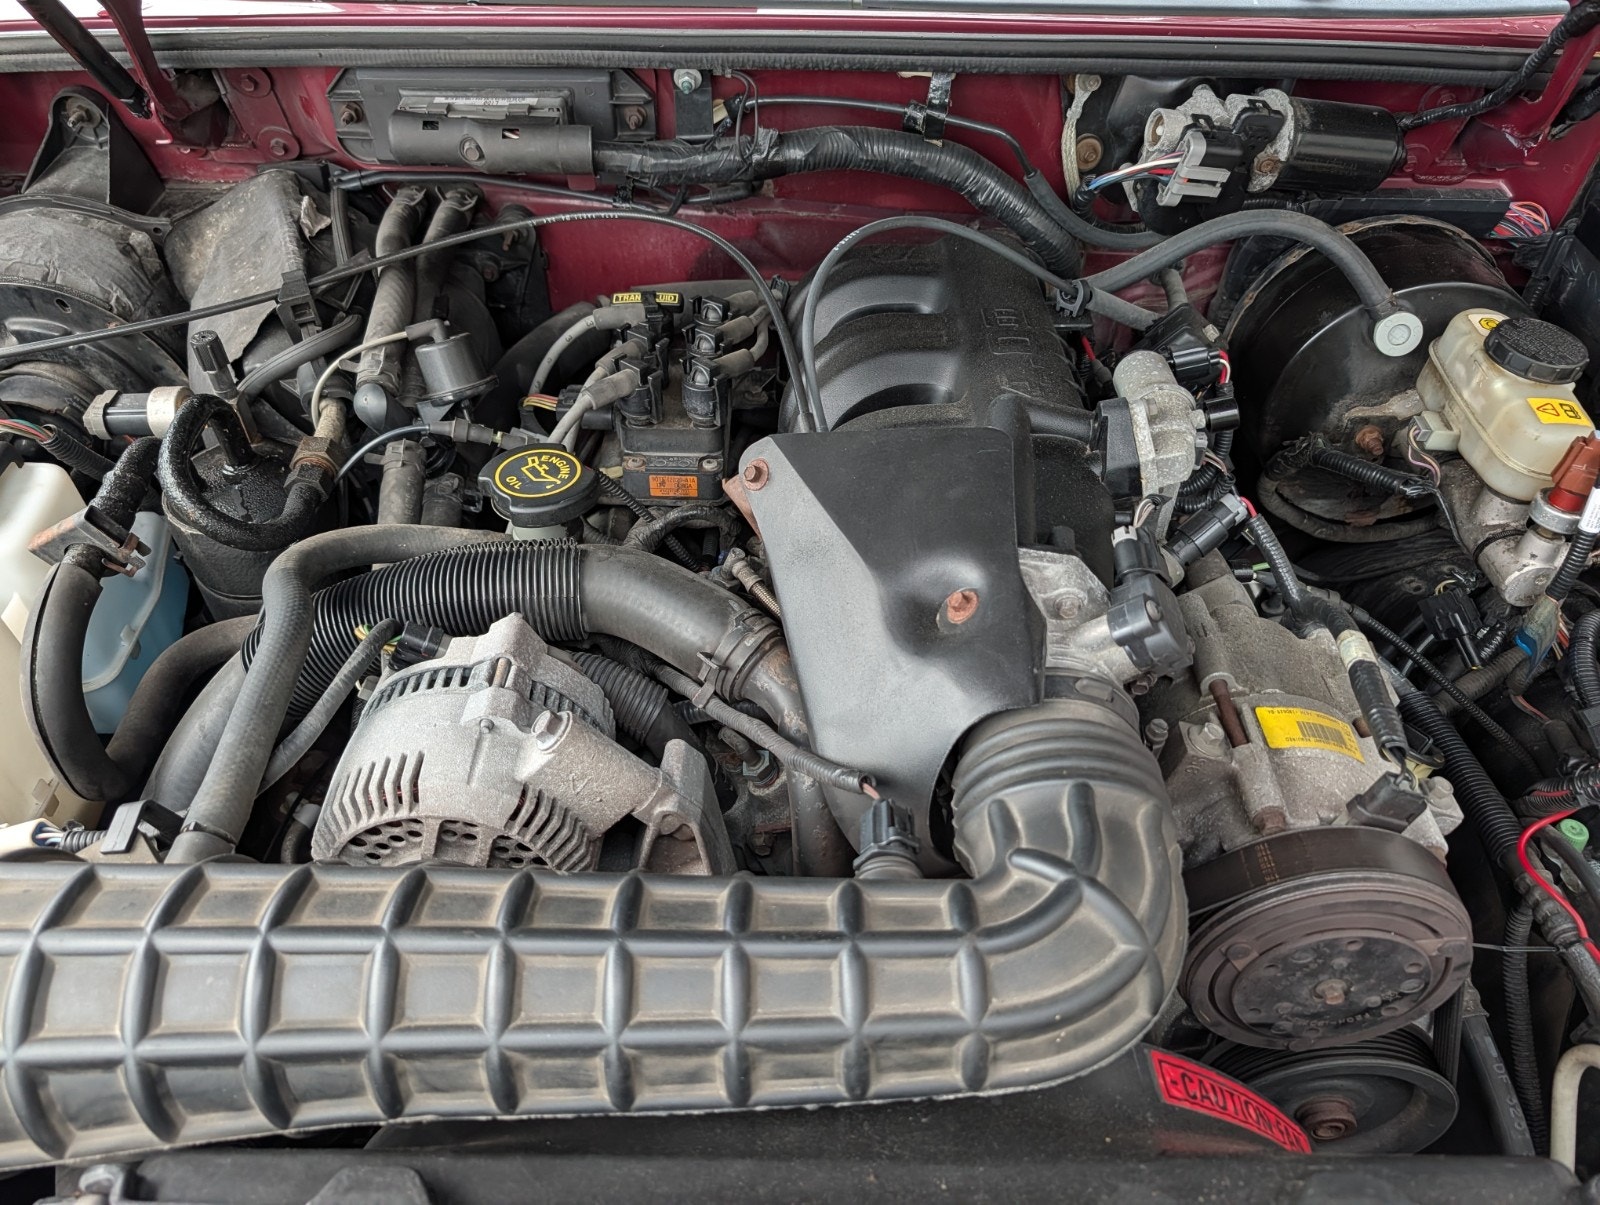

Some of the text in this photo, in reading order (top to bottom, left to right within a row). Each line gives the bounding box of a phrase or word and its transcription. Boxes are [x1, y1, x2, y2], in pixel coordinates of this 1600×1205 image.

[618, 294, 642, 303] TRAN
[540, 454, 572, 480] ENGINE
[505, 475, 523, 490] OIL
